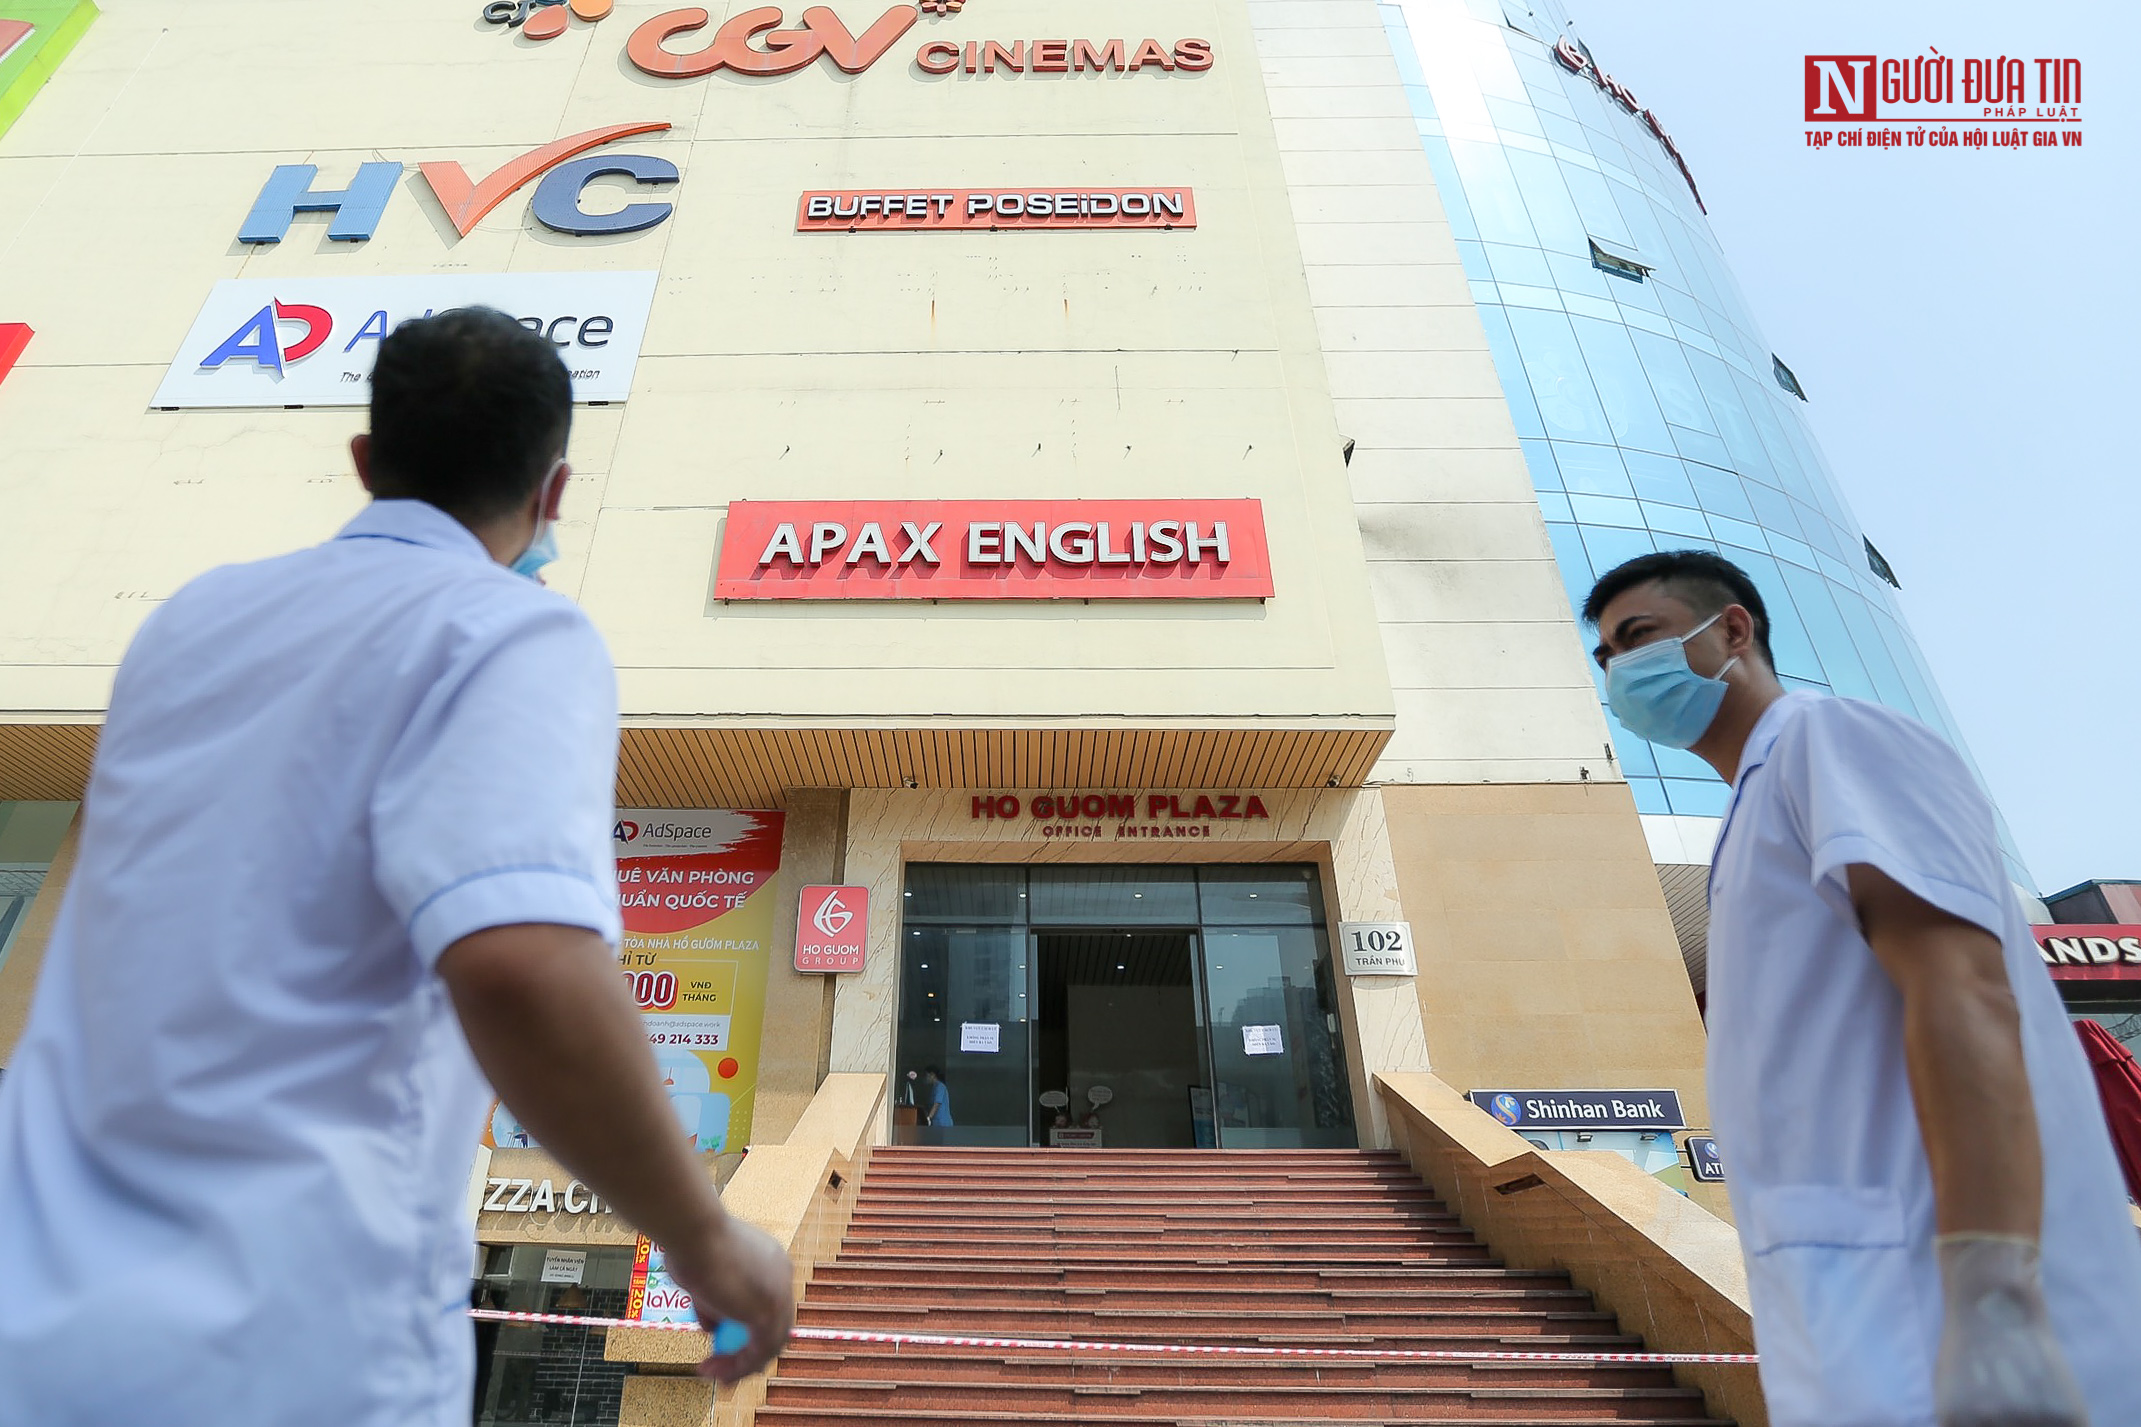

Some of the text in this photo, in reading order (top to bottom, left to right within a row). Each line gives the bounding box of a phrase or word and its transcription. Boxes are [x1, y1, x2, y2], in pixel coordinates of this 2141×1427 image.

[627, 6, 1214, 78] CGV CINEMAS
[237, 122, 680, 243] HVC
[807, 194, 954, 219] BUFFET
[758, 520, 1230, 566] APAX ENGLISH
[971, 795, 1270, 819] HO GUOM PLAZA
[642, 823, 712, 841] AdSpace
[1042, 825, 1211, 838] OFFICE ENTRANCE
[614, 867, 755, 885] UÊ VĂN PHÒNG
[617, 889, 748, 910] UẨN QUỐC TẾ
[725, 940, 760, 951] PLAZA
[803, 944, 860, 956] HO GUOM
[1351, 930, 1403, 952] 102
[802, 956, 860, 966] GROUP
[690, 981, 712, 989] VNĐ
[682, 992, 717, 1002] THÁNG
[669, 1034, 691, 1045] 214
[695, 1034, 719, 1046] 333
[1525, 1098, 1666, 1120] Shinhan Bank
[483, 1177, 556, 1213] ZZA
